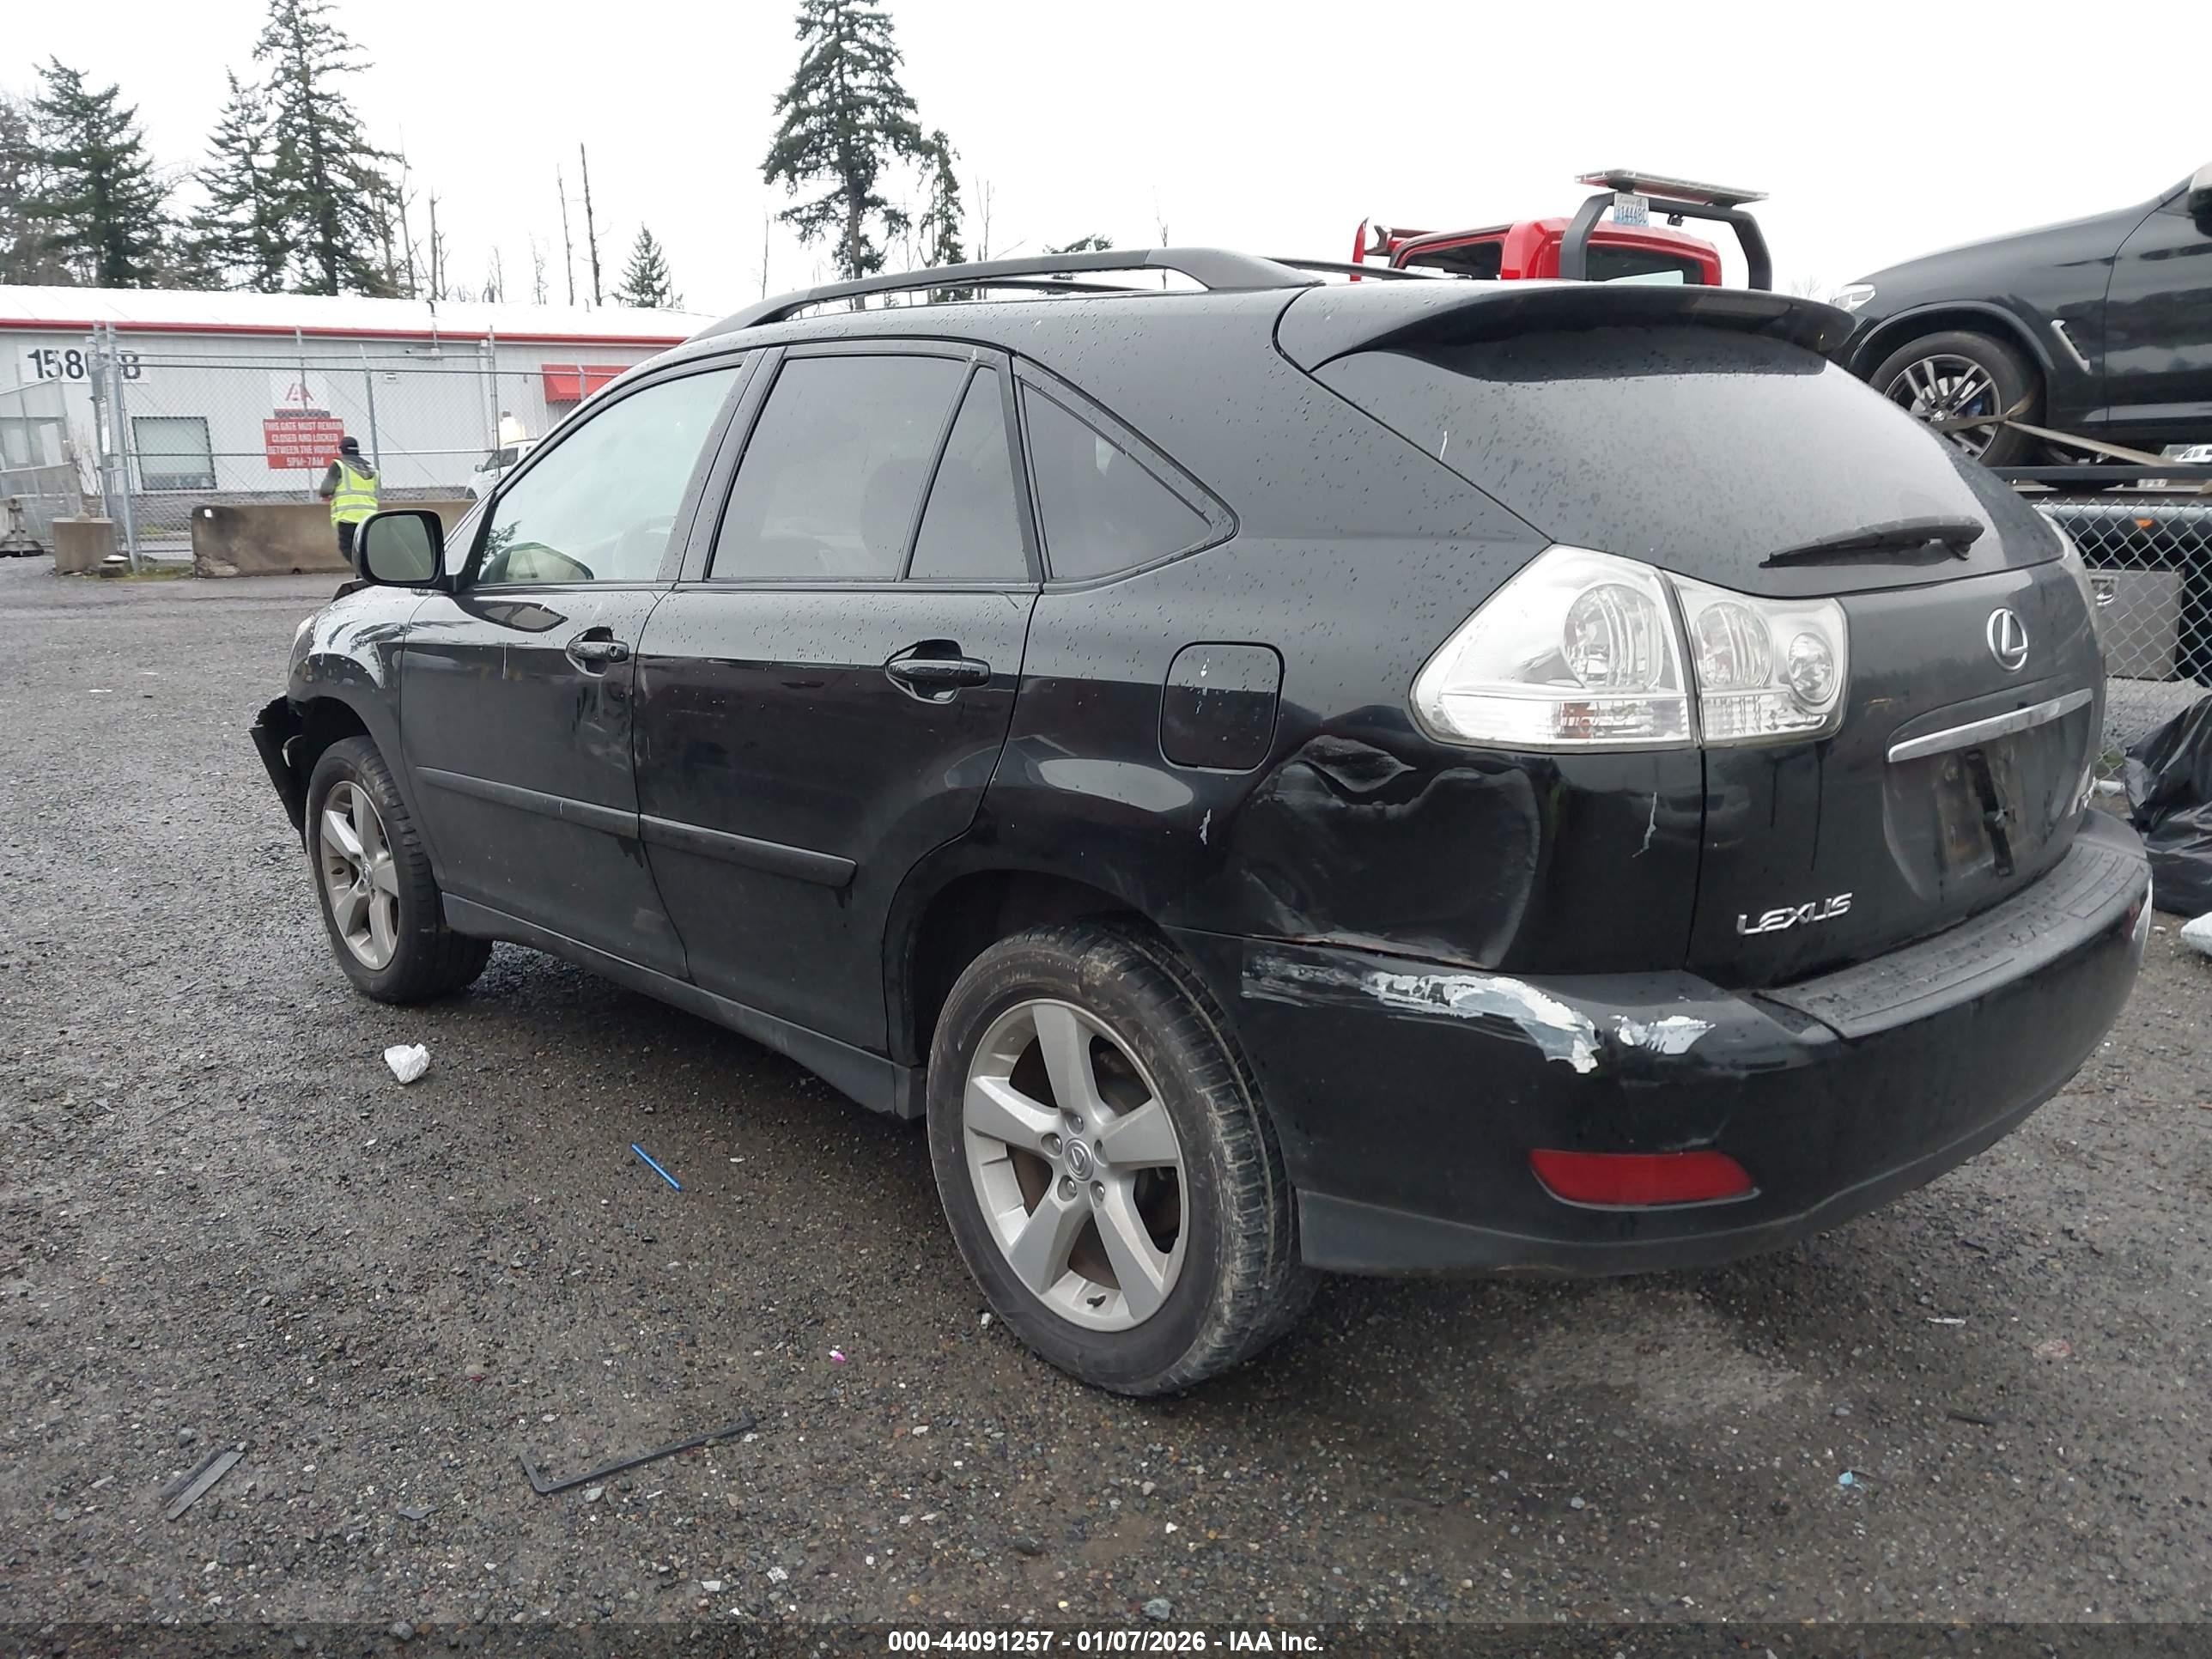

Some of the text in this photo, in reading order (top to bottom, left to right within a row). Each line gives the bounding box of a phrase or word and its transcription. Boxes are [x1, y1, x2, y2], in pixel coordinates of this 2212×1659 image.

[265, 422, 343, 430] THIS GATE MUST REMAIN
[271, 434, 338, 442] CLOSED AND LOCKED
[267, 446, 299, 454] BETWEEN
[300, 446, 313, 454] THE
[313, 446, 336, 454] HOURS
[287, 457, 325, 466] 5PM-7AM
[1736, 892, 1853, 935] LEXUS
